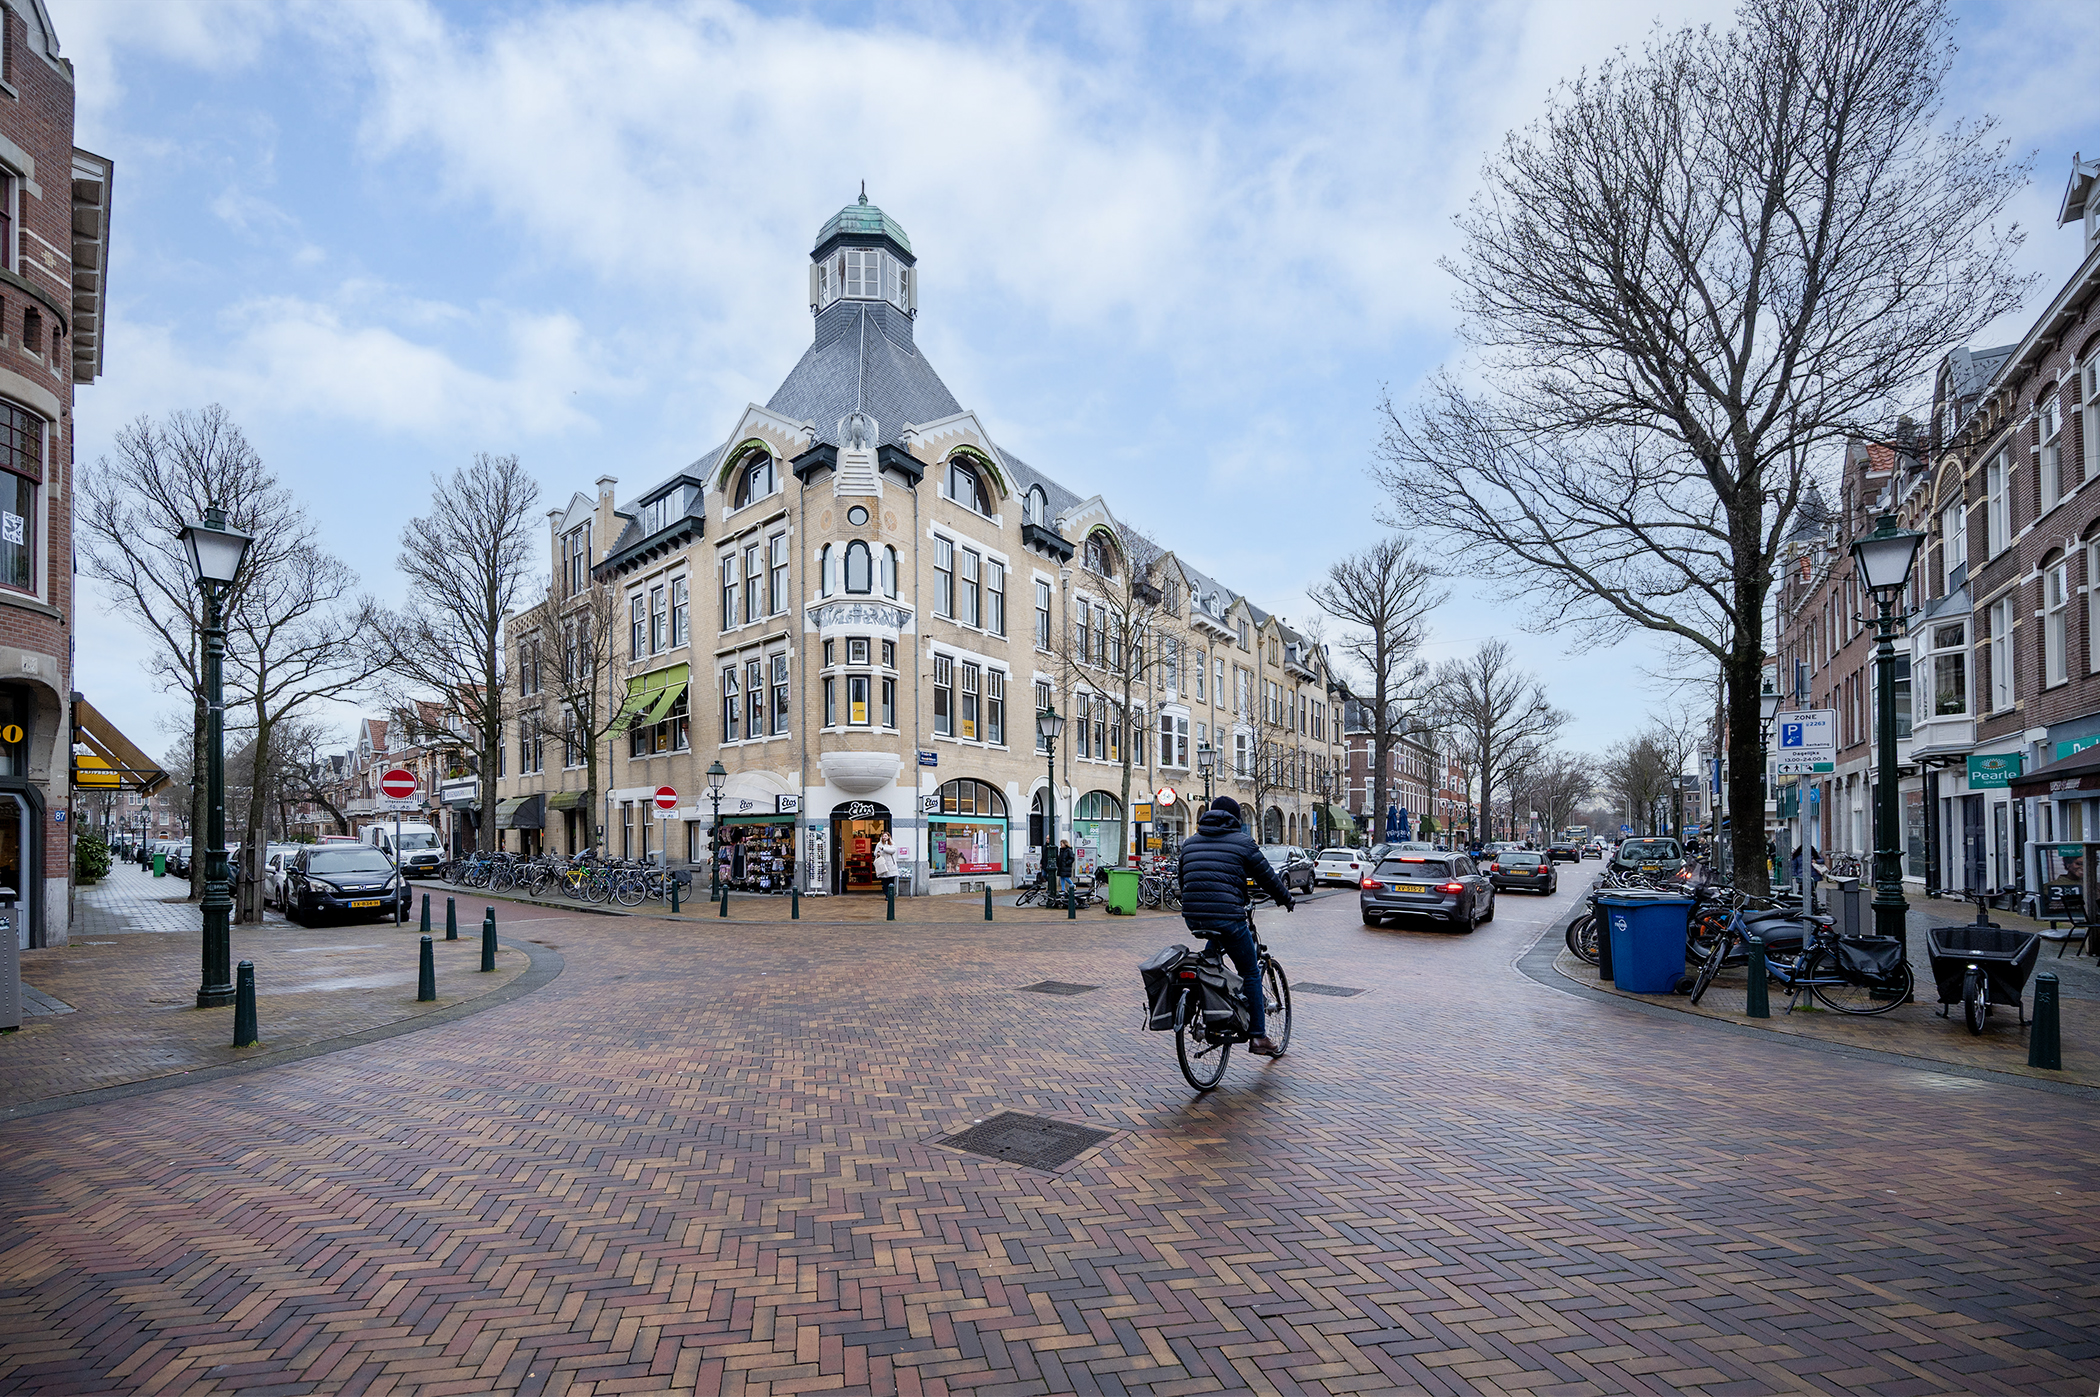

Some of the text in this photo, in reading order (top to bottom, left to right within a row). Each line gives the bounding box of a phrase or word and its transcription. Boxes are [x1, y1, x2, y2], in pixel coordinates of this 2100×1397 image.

[0, 724, 24, 743] O
[1788, 725, 1798, 736] P
[1972, 770, 2017, 780] Pearle
[739, 799, 754, 812] Etos
[782, 797, 797, 810] Etos
[925, 797, 939, 810] Etos
[55, 812, 65, 820] 87
[848, 801, 875, 821] Etos
